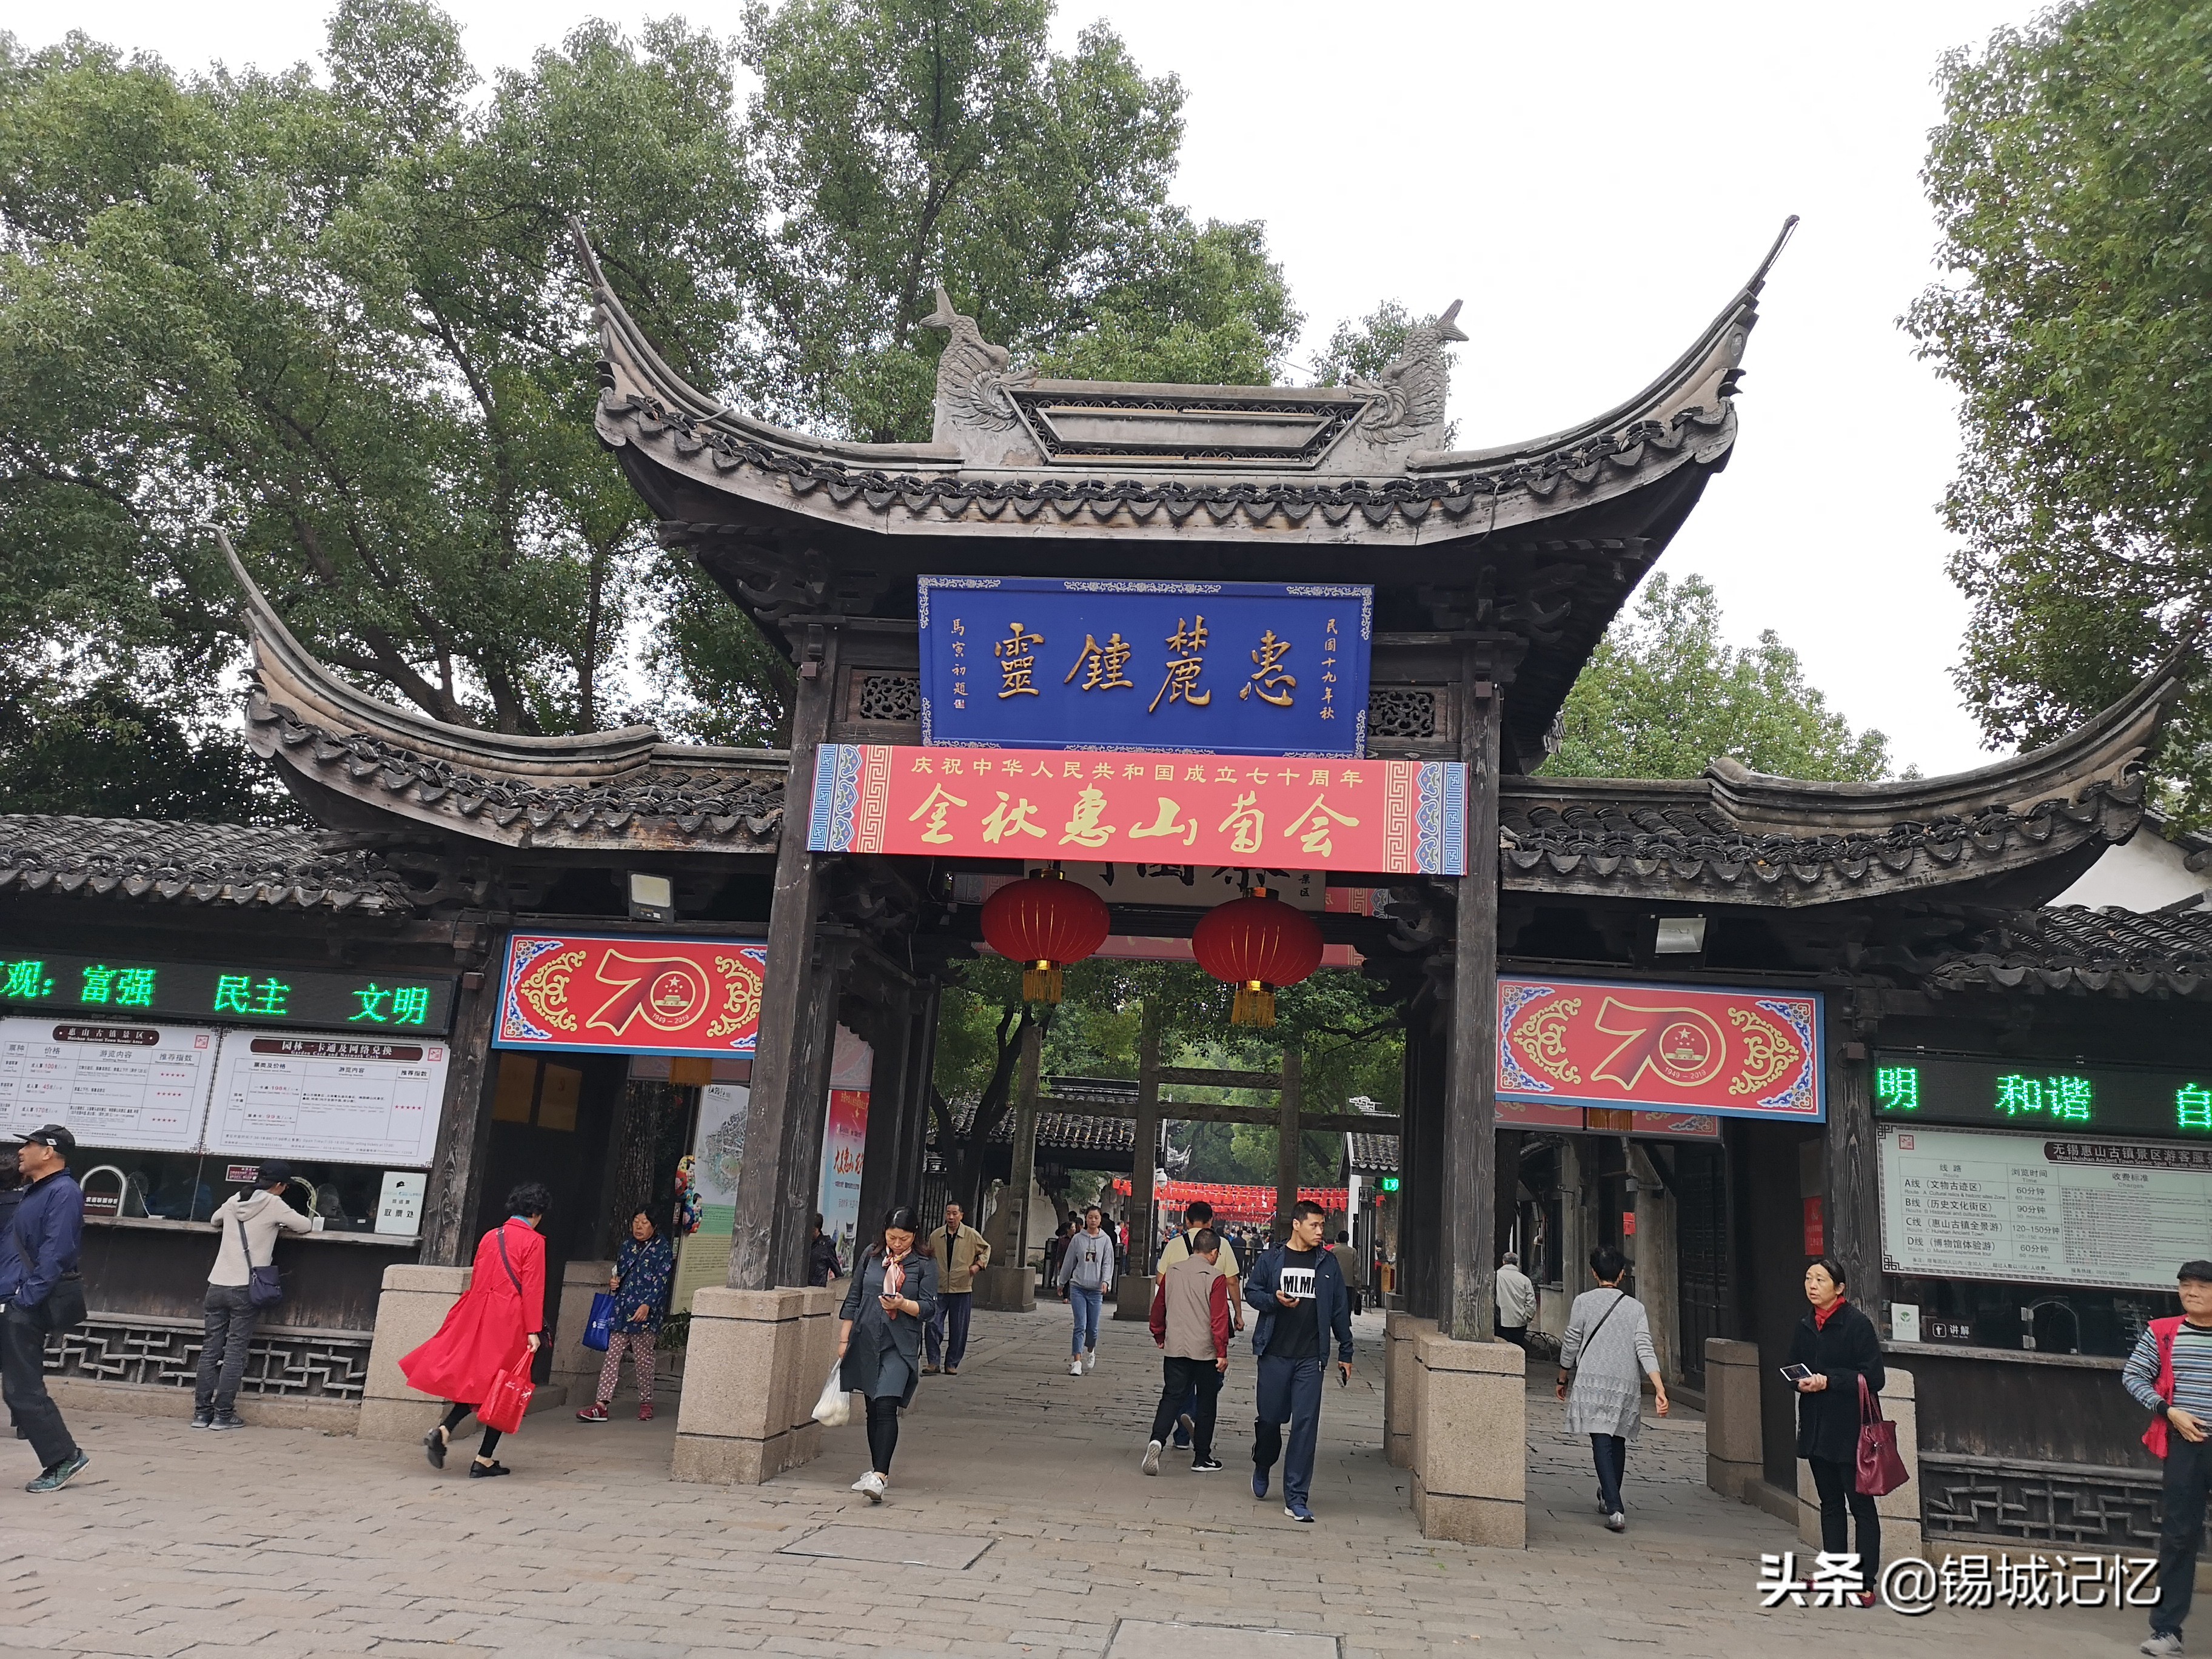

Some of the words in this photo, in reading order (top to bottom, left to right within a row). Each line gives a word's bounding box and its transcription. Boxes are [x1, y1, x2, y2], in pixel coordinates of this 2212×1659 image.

[951, 618, 969, 697] 馬寅初題
[1319, 617, 1338, 720] 民國十九年秋
[911, 756, 1364, 789] 庆祝中华人民共和国成立七十周年
[908, 782, 1359, 857] 金秋惠山菊会
[81, 964, 156, 1007] 富强
[214, 974, 292, 1016] 民主
[348, 982, 429, 1025] 文明
[99, 1050, 132, 1059] 游览内容
[159, 1053, 193, 1061] 推荐指数
[281, 1040, 392, 1056] 园林一卡通及网络兑换
[1877, 1067, 1919, 1110] 明
[1994, 1073, 2092, 1121] 和谐
[2176, 1082, 2212, 1128] 自
[1939, 1164, 1962, 1172] 线路
[2011, 1168, 2048, 1178] 浏览时间
[2112, 1172, 2149, 1182] 收费标准
[2016, 1187, 2045, 1196] 60分钟
[384, 1208, 414, 1218] 取票处
[2017, 1205, 2046, 1213] 90分钟
[2020, 1244, 2049, 1253] 60分钟
[1949, 1324, 1970, 1335] 讲解
